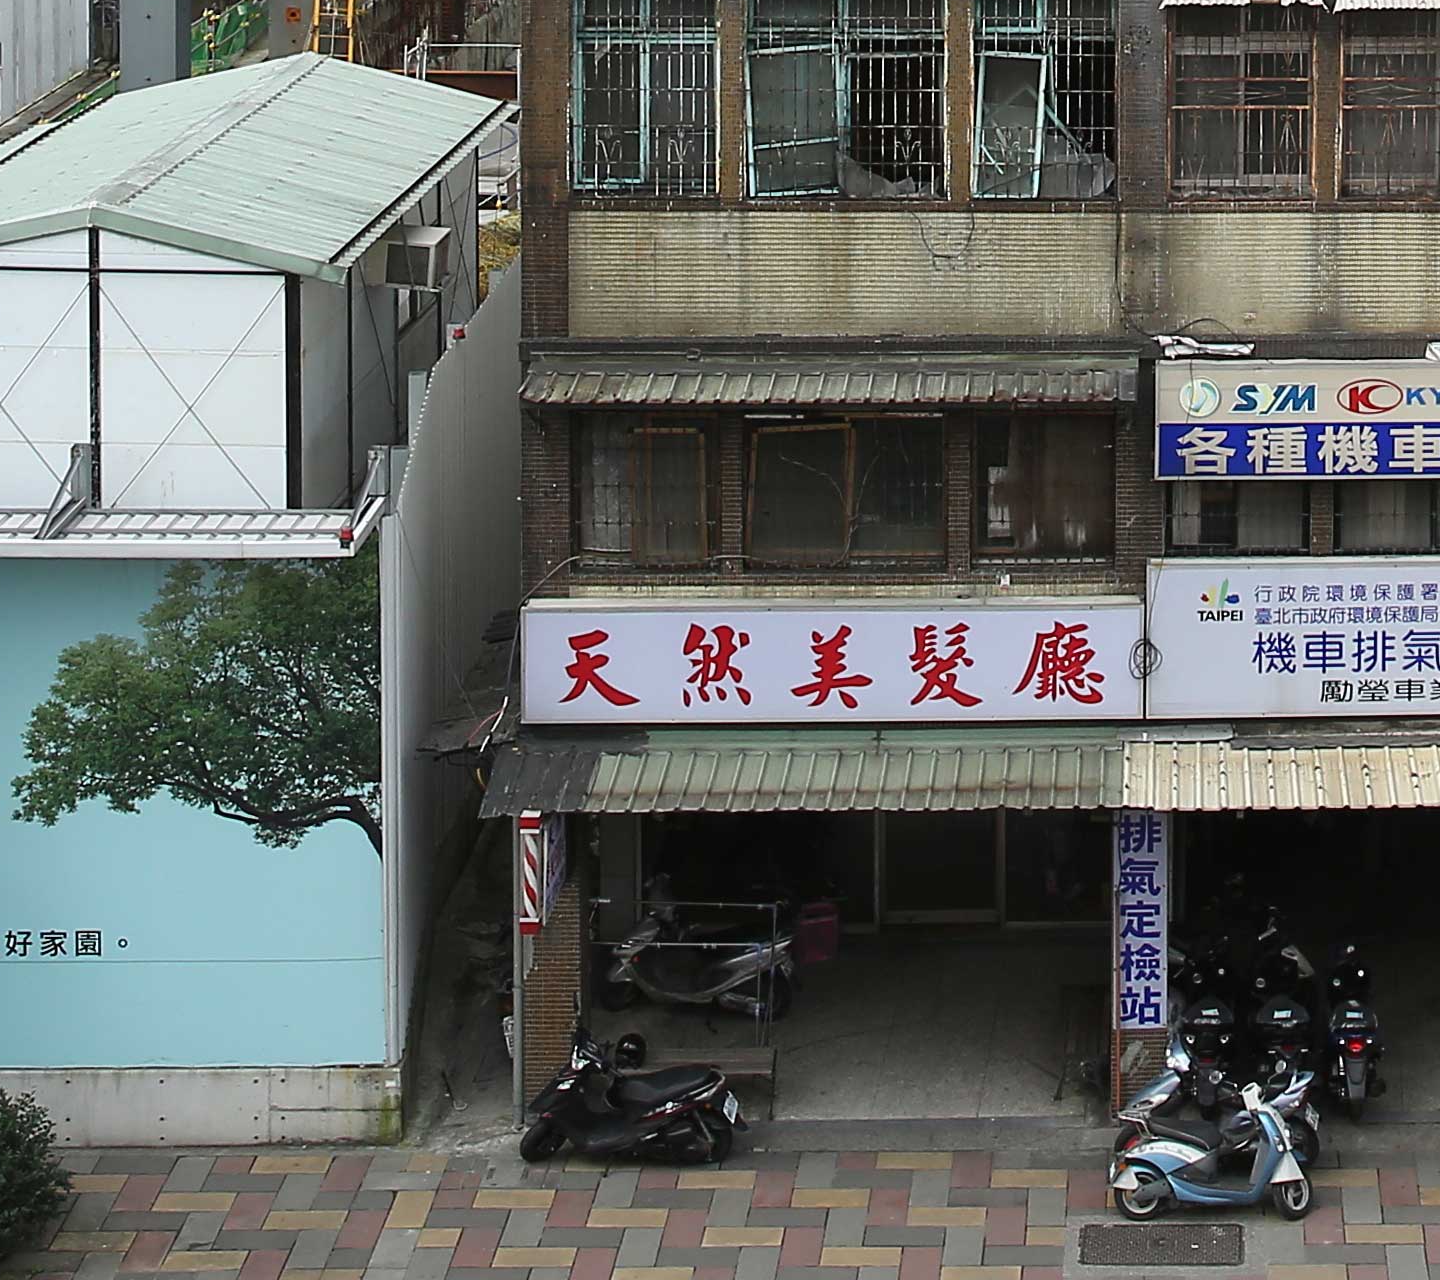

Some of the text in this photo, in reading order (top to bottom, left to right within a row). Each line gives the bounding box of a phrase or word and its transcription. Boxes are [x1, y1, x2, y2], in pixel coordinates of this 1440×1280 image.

[1231, 382, 1317, 416] SYM
[1254, 583, 1440, 603] 行政院環境保護署
[1197, 610, 1244, 622] TAIPEI
[1254, 605, 1439, 624] 臺北市政府環境保護局
[558, 619, 1106, 710] 天然美髮廳
[1119, 813, 1163, 1026] 排氣定檢站
